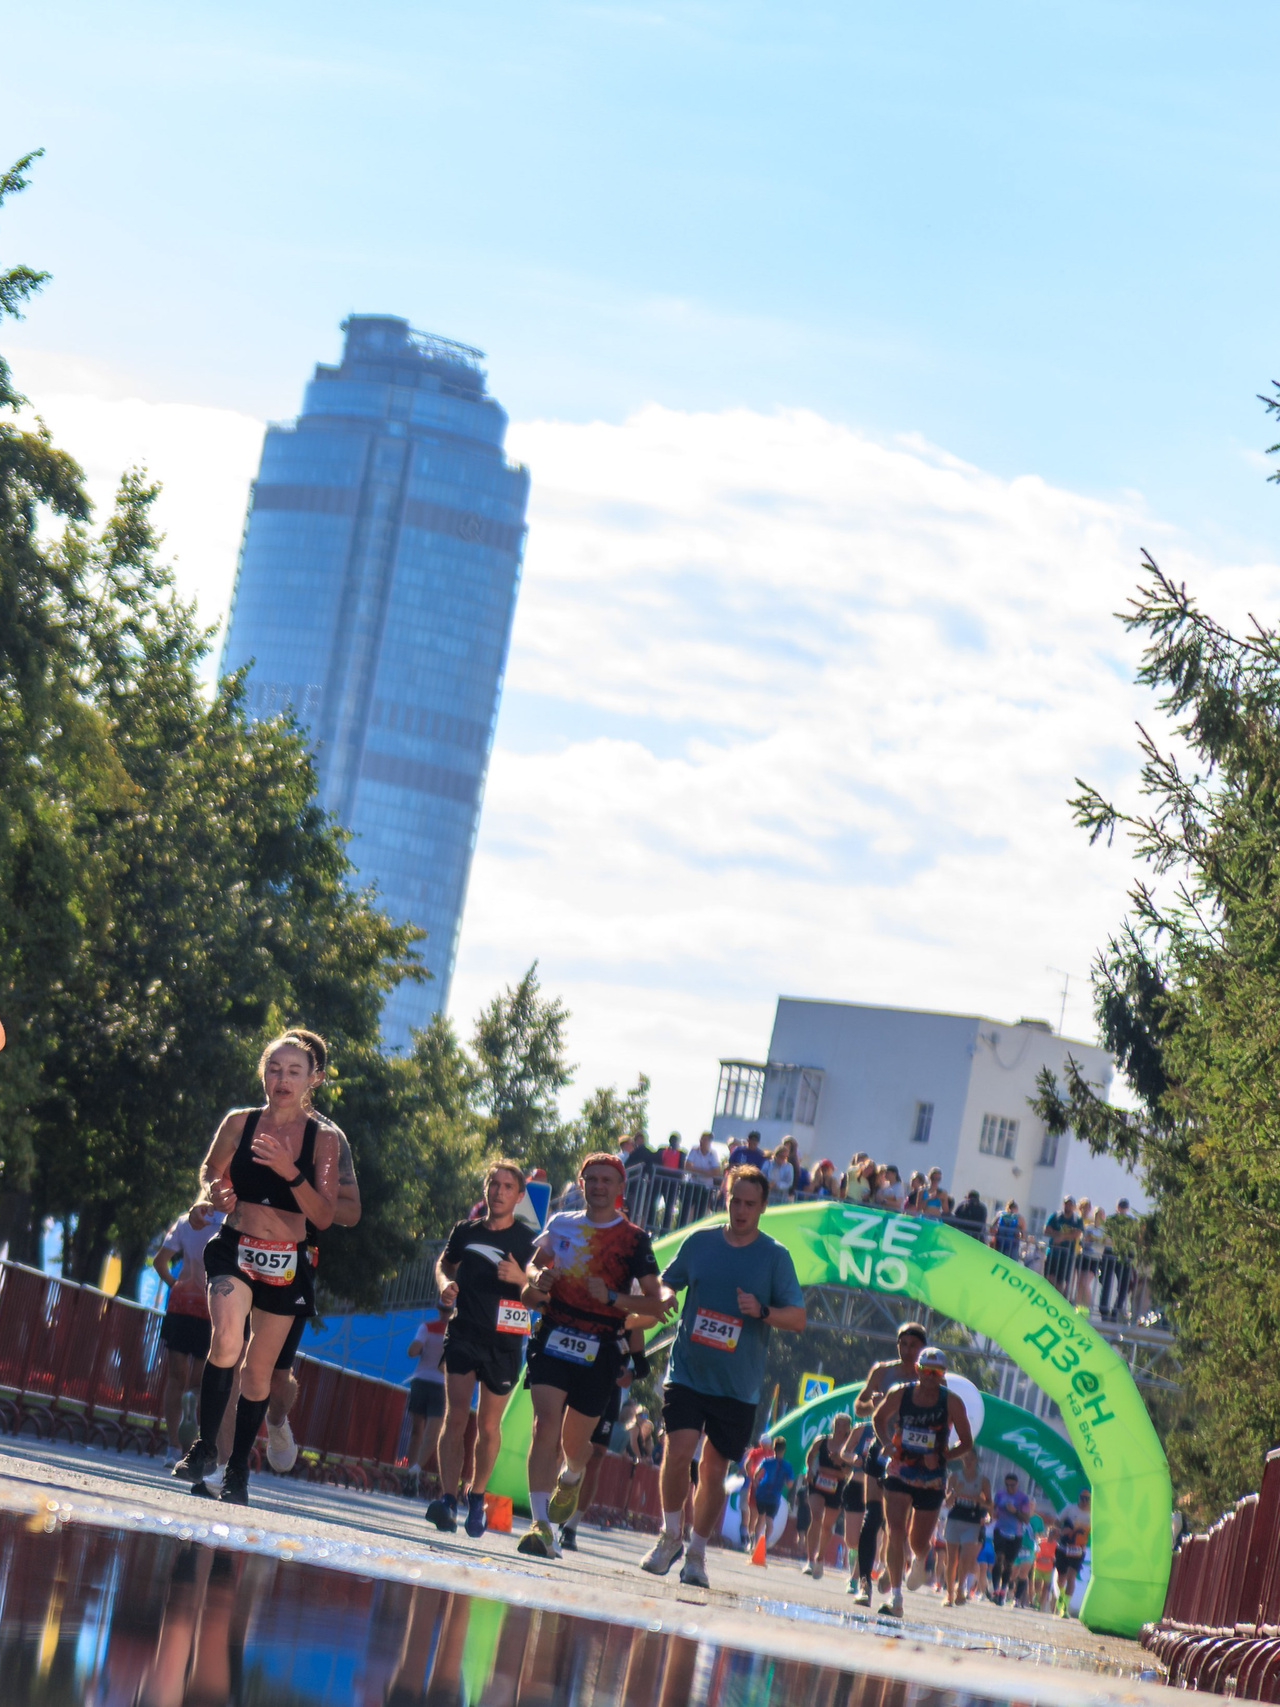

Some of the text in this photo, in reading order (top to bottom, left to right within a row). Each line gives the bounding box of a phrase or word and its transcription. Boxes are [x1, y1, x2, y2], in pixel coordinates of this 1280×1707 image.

[840, 1211, 922, 1256] ZE
[244, 1249, 292, 1269] 3057
[839, 1250, 908, 1291] NO
[991, 1263, 1094, 1353] Попробуй
[699, 1318, 735, 1338] 2541
[559, 1336, 587, 1353] 419
[908, 1432, 929, 1444] 278
[1066, 1392, 1103, 1468] на вкус
